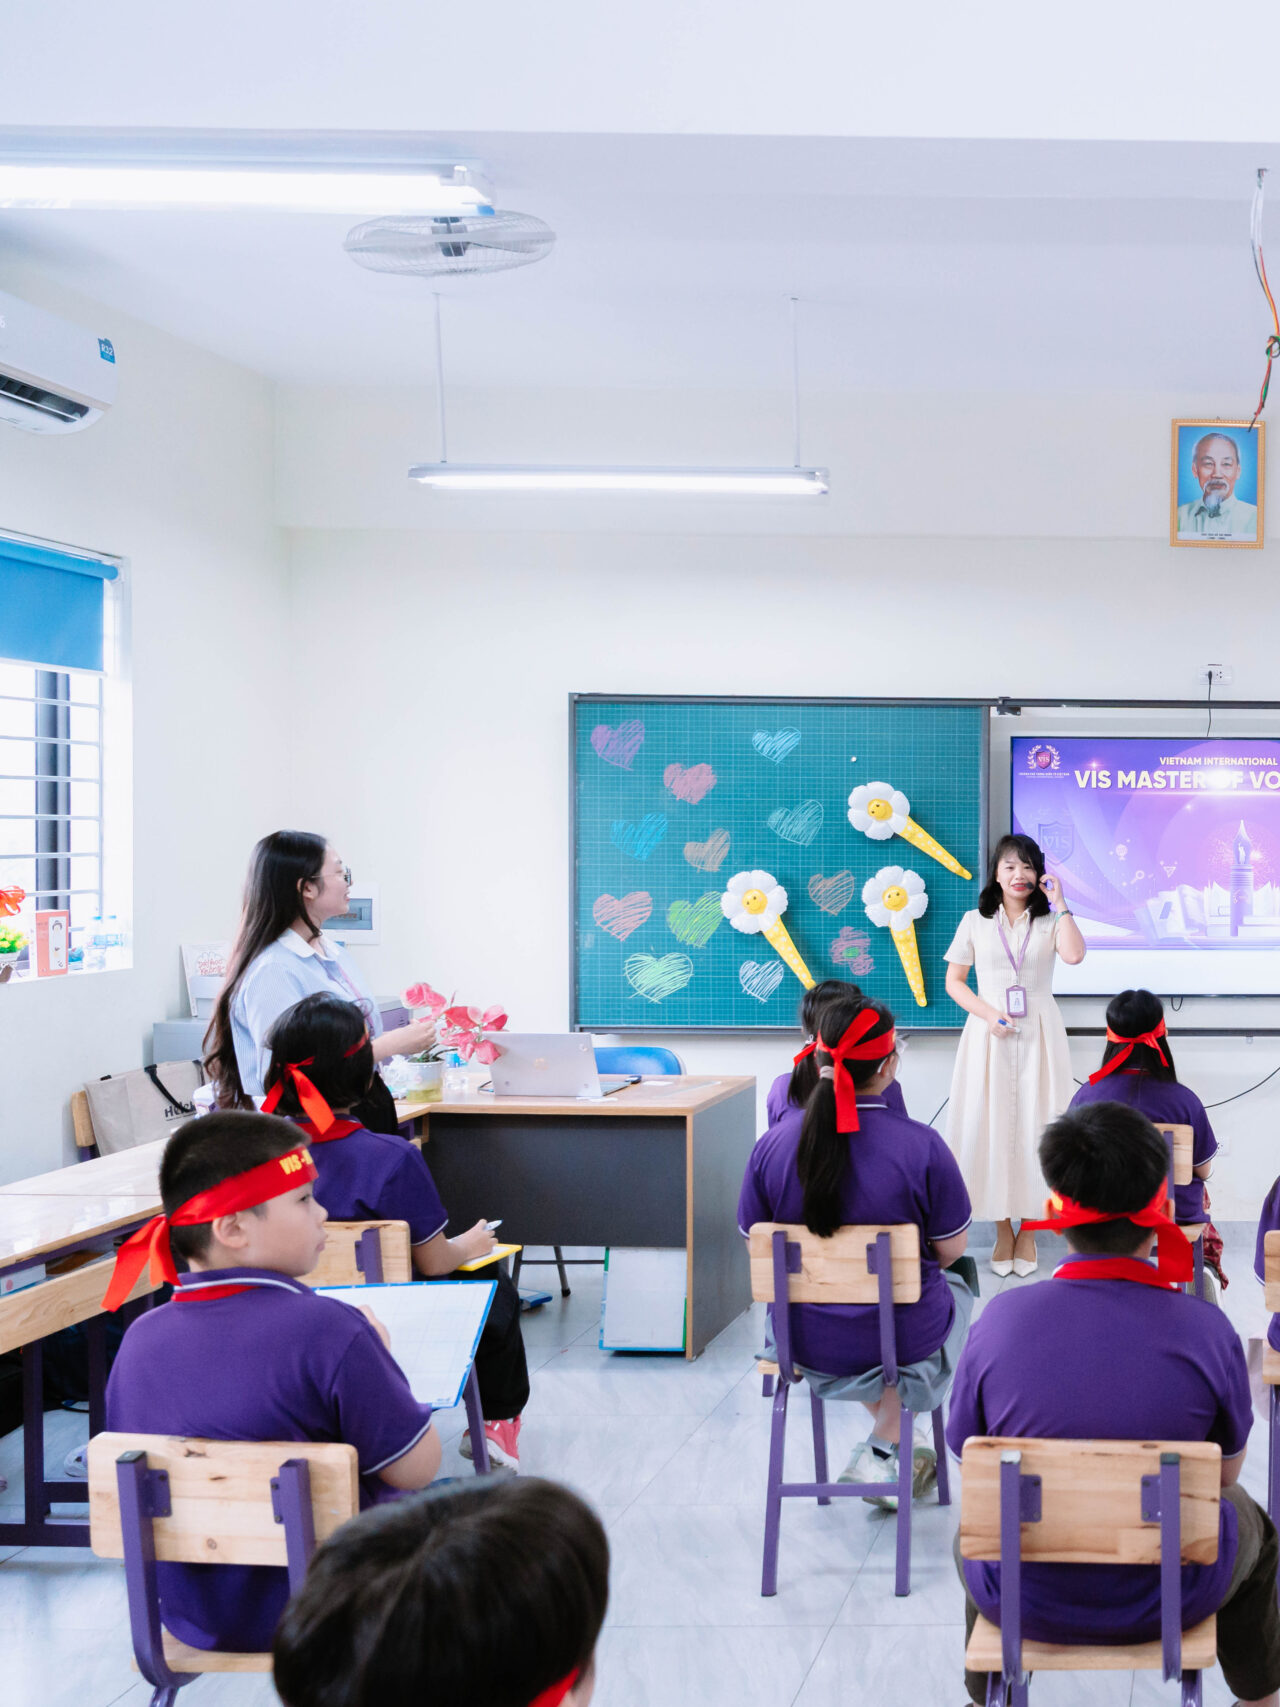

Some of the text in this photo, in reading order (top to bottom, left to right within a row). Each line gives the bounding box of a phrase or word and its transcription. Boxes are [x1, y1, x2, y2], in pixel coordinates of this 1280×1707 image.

[1159, 756, 1202, 766] VIETNAM
[1204, 757, 1278, 766] INTERNATIONAL
[1074, 770, 1112, 789] VIS
[1117, 770, 1206, 790] MASTER
[1207, 771, 1244, 790] F
